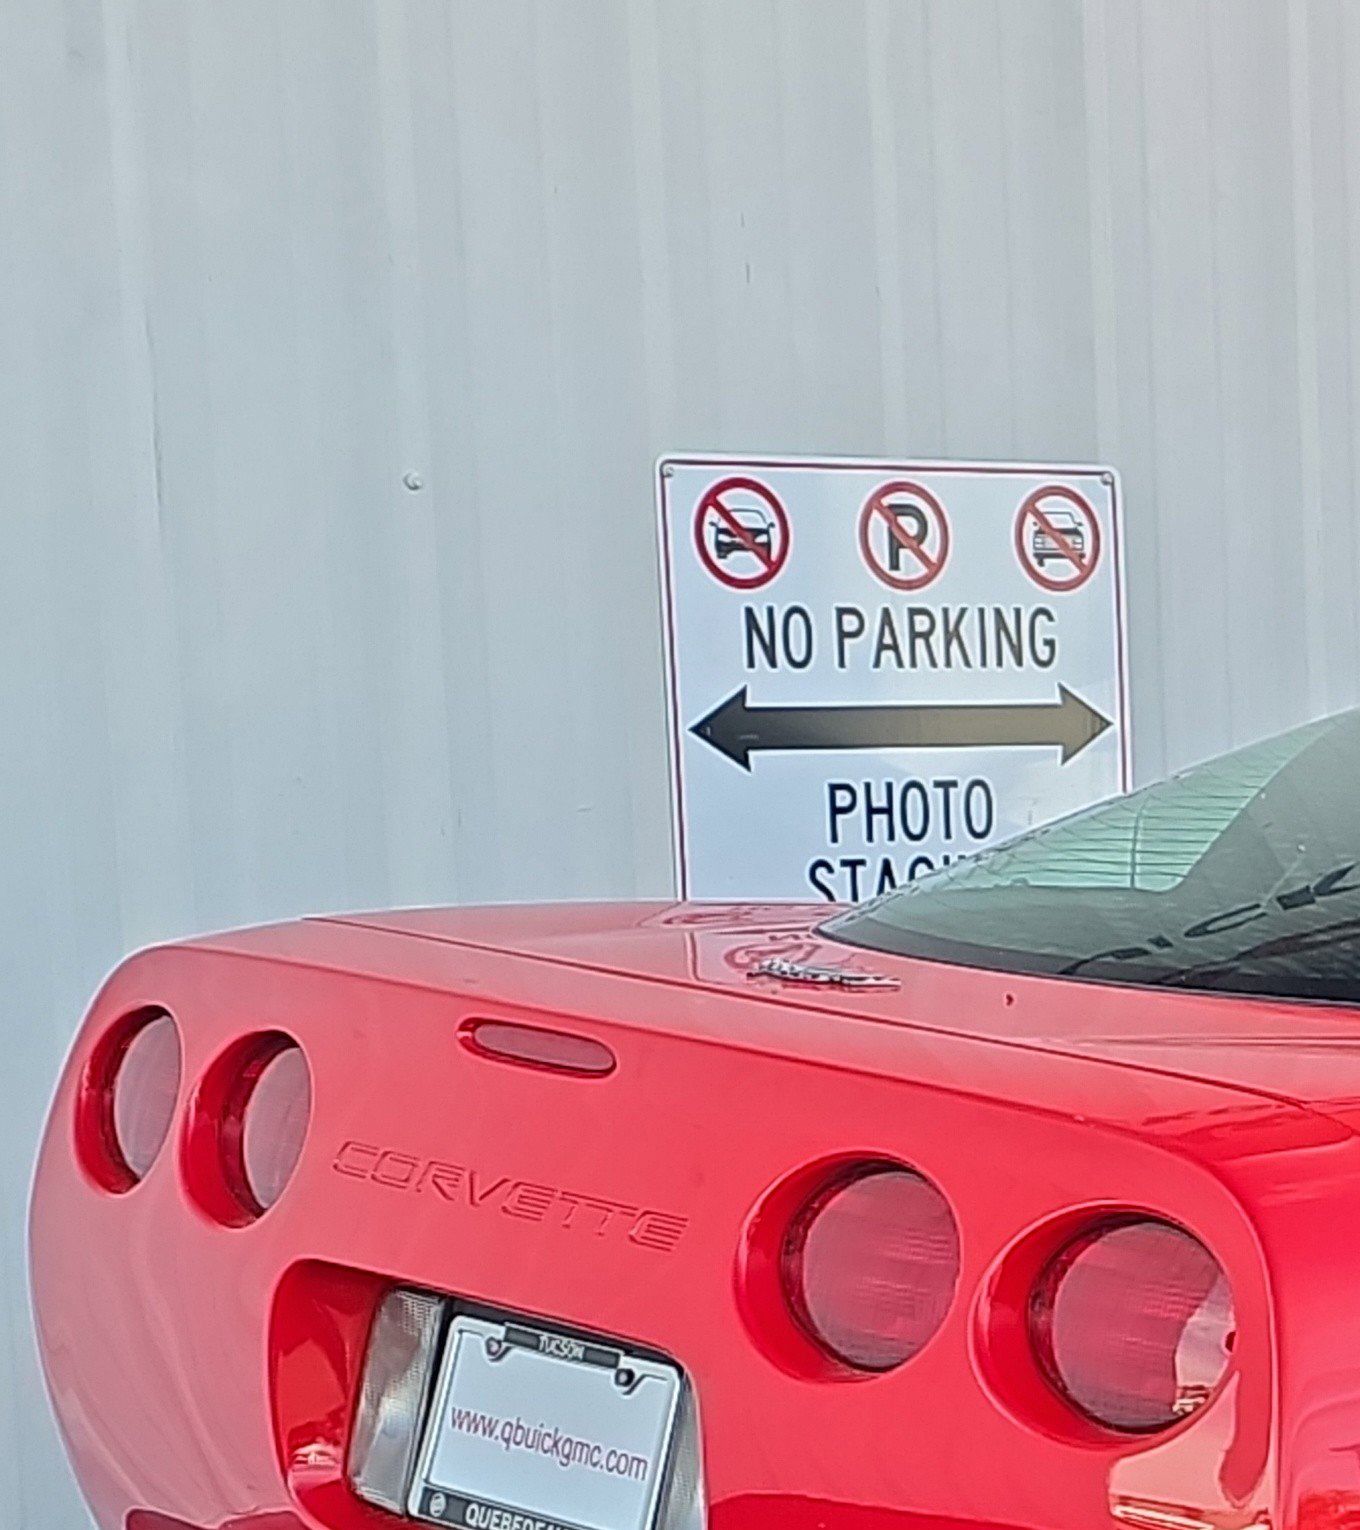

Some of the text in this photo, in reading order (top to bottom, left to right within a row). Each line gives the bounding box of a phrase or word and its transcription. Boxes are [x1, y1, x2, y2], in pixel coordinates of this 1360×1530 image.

[745, 606, 1058, 669] NO PARKING
[827, 779, 994, 844] PHOTO
[333, 1140, 690, 1252] CORVETTE
[539, 1332, 585, 1360] TUCSON
[451, 1406, 649, 1481] www.qbuickgmc.com
